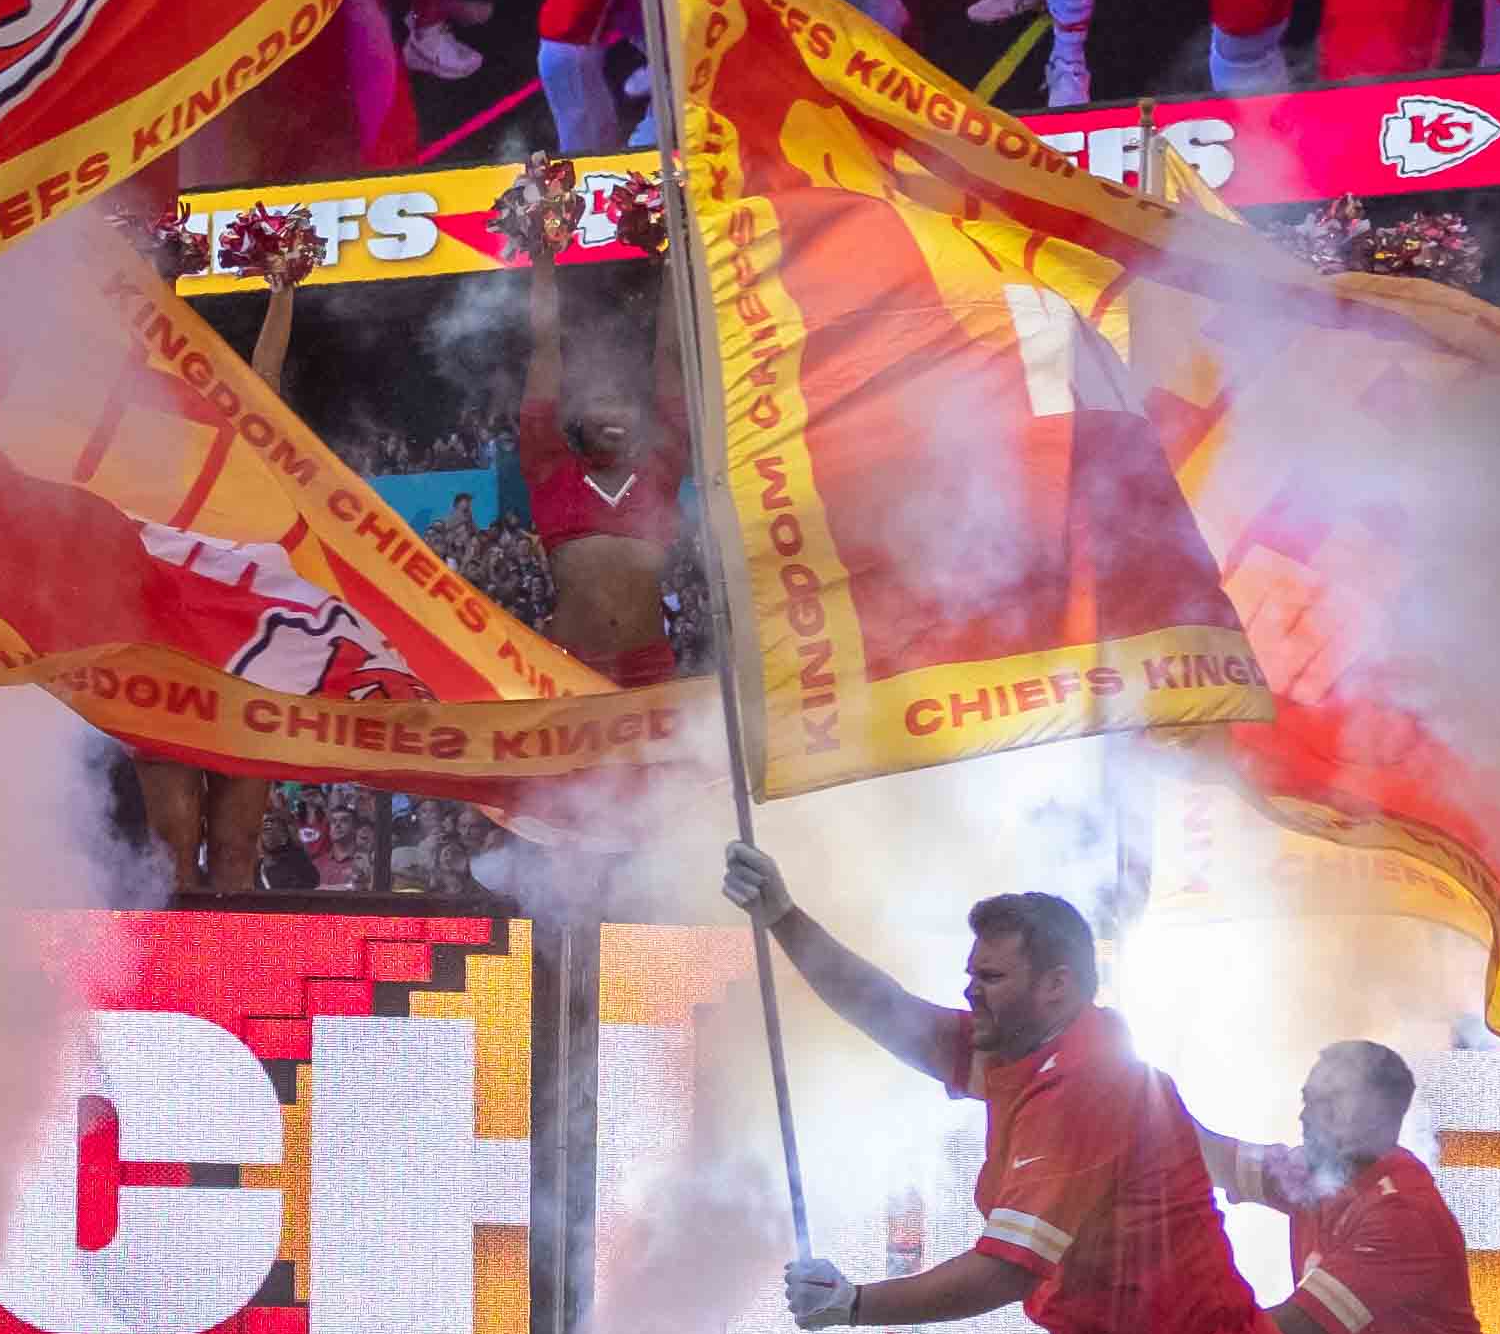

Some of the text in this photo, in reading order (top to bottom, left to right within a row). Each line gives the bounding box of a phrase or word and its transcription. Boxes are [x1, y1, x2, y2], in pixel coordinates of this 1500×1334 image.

[844, 50, 1078, 180] KINGDOM
[326, 488, 490, 635] CHIEFS
[754, 453, 843, 755] KINGDOM
[903, 665, 1125, 737] CHIEFS
